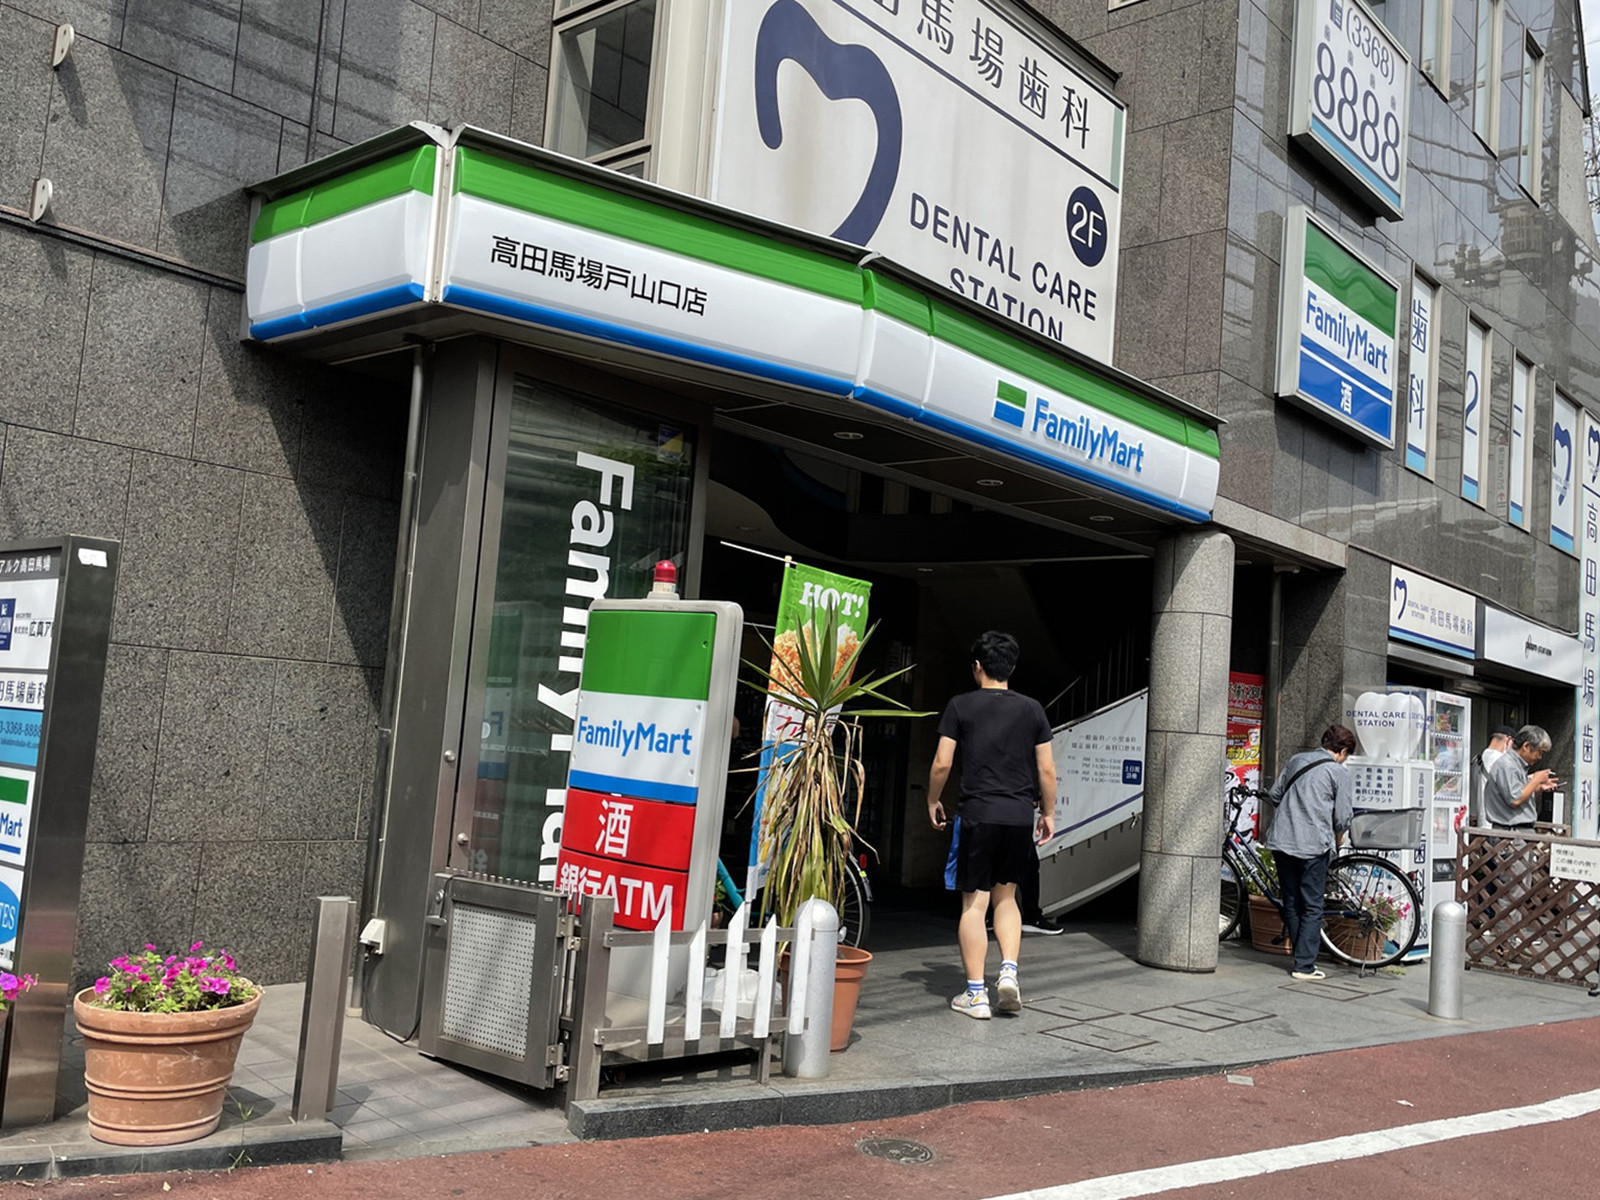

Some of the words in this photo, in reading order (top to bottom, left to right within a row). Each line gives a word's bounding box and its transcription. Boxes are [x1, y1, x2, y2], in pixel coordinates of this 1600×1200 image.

[874, 0, 1090, 149] 馬場歯科
[1346, 7, 1395, 85] (3368)
[1313, 42, 1400, 182] 8888
[910, 192, 1021, 282] DENTAL
[1032, 262, 1097, 322] CARE
[1071, 202, 1104, 248] 2F
[491, 235, 708, 317] 高田馬場戸山口店
[1305, 289, 1389, 375] FamilyMart
[1340, 381, 1352, 415] 酒
[1033, 397, 1144, 473] FamilyMart
[798, 581, 864, 618] HOT!
[1580, 502, 1598, 821] 高田馬場歯科
[577, 717, 693, 757] FamilyMart
[1346, 710, 1379, 719] DENTAL
[1382, 711, 1406, 719] CARE
[1357, 720, 1395, 728] STATION
[594, 797, 634, 858] 酒
[559, 861, 675, 923] 銀行ATM
